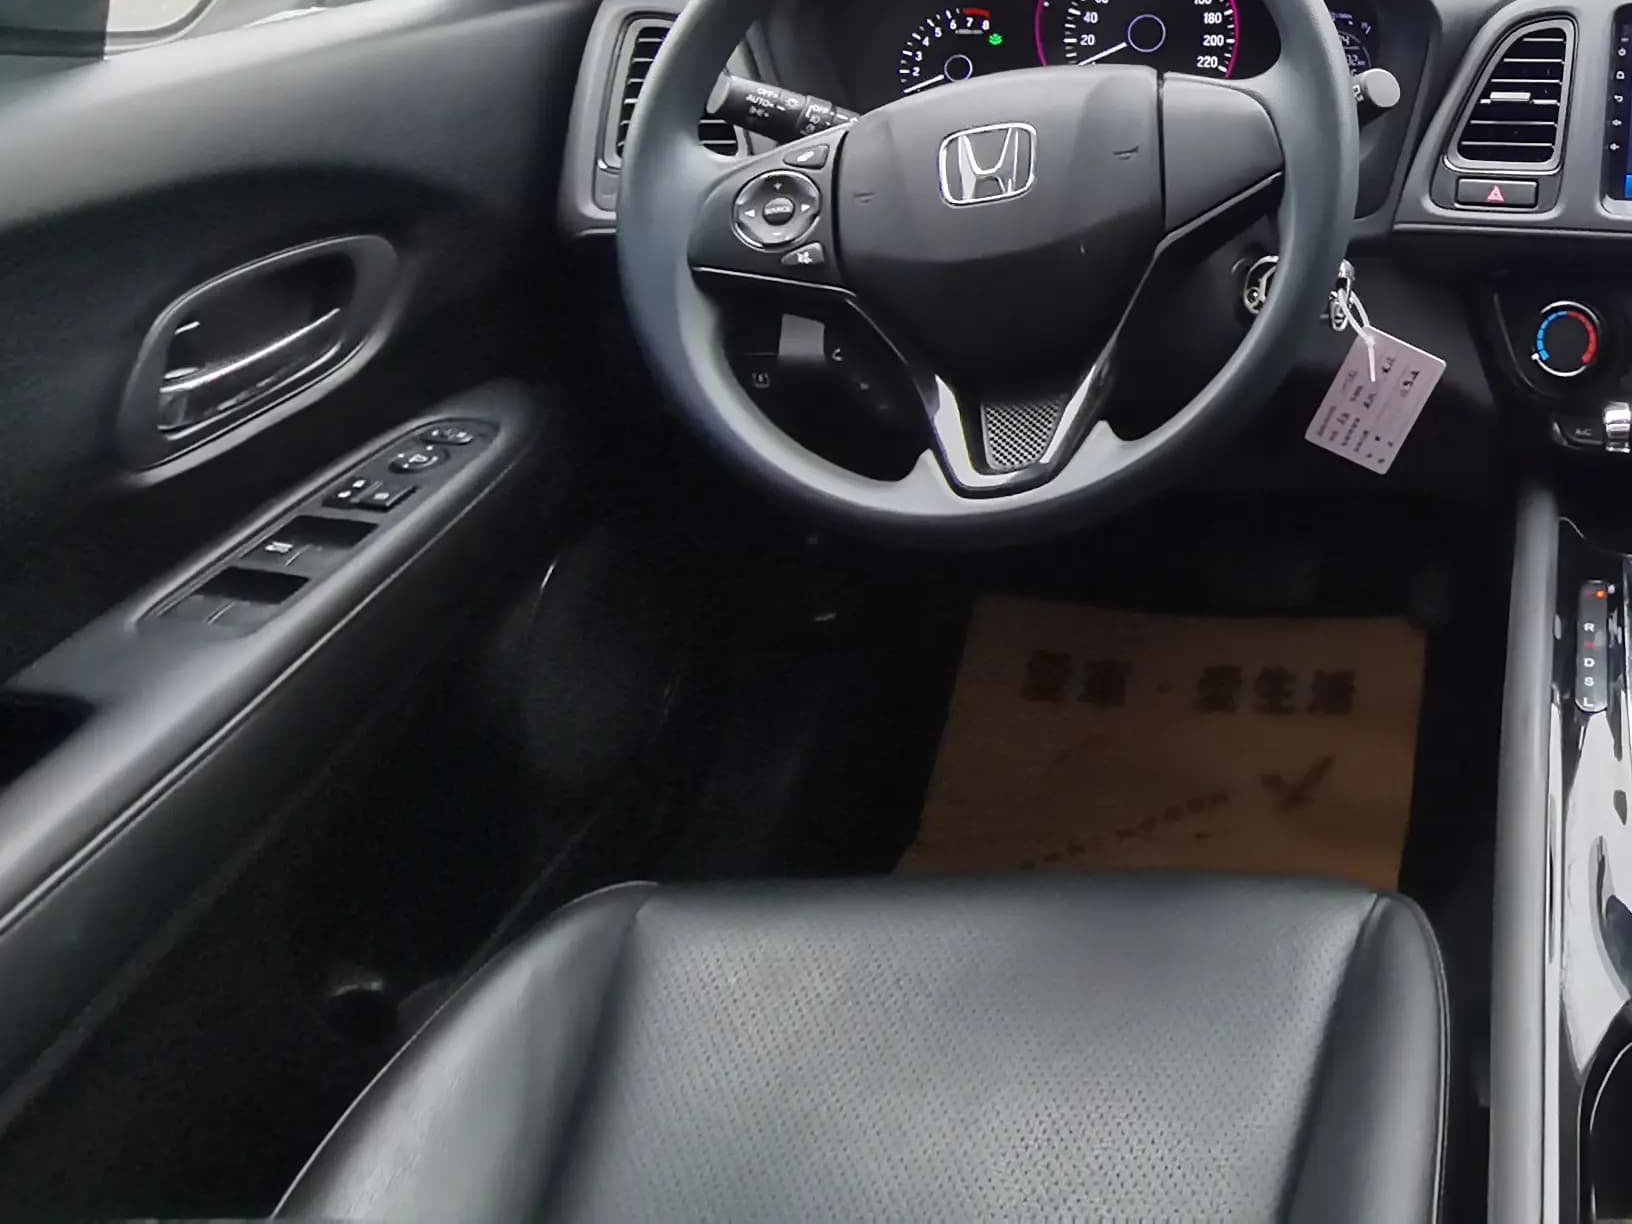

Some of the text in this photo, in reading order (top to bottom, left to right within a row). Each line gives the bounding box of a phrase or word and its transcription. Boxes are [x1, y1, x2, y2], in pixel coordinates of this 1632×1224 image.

[965, 16, 974, 27] 7
[1083, 11, 1098, 24] 40
[1203, 12, 1222, 24] 180
[949, 19, 957, 30] 6
[982, 19, 990, 30] 8
[934, 27, 942, 38] 5
[922, 36, 930, 47] 4
[1080, 34, 1095, 46] 20
[1202, 34, 1225, 47] 200
[914, 51, 923, 61] 3
[1196, 55, 1218, 68] 220
[912, 66, 921, 76] 2
[745, 94, 769, 107] AUTO
[1584, 622, 1595, 633] R
[1584, 657, 1595, 668] D
[1584, 676, 1595, 687] S
[1583, 696, 1594, 707] L
